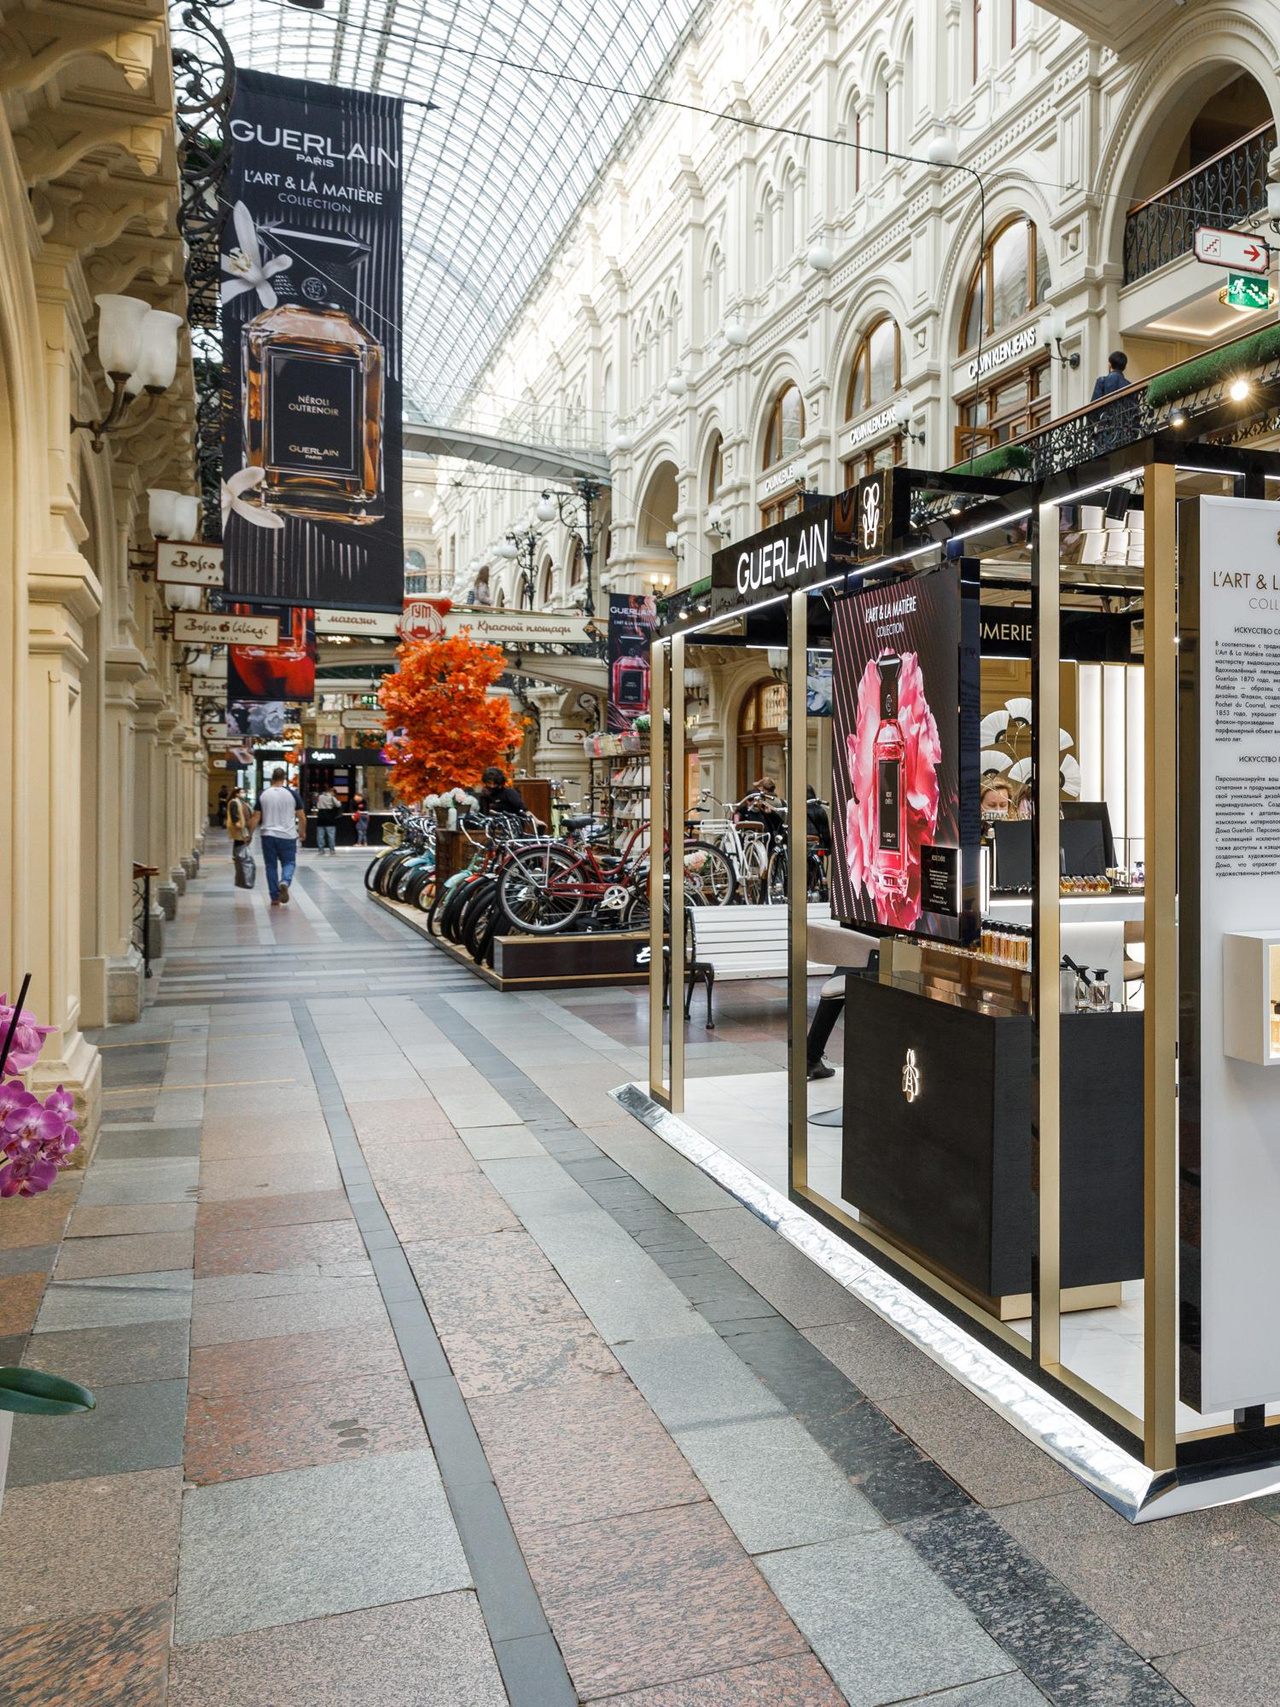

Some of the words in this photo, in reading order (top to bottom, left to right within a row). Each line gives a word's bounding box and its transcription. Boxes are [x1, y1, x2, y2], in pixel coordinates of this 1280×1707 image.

[229, 119, 399, 169] GUERLAIN
[296, 153, 335, 168] PARIS
[244, 169, 281, 187] L'ART
[284, 176, 296, 190] &
[300, 178, 319, 194] LA
[322, 183, 384, 206] MATIÈRE
[278, 192, 352, 214] COLLECTION
[968, 352, 992, 379] CALVIN
[992, 340, 1011, 366] KLEIN
[1011, 327, 1036, 357] JEANS
[297, 395, 330, 406] NÉROLI
[288, 403, 339, 416] OUTRENOIR
[288, 444, 339, 457] GUERLAIN
[171, 551, 216, 573] Bosco
[737, 519, 828, 595] GUERLAIN
[1213, 571, 1251, 588] L'ART
[1256, 574, 1267, 589] &
[411, 604, 432, 619] ГУМ
[885, 603, 892, 619] LA
[893, 594, 917, 617] MATIÈRE
[184, 618, 217, 634] Bosco
[327, 615, 377, 626] магазин
[459, 622, 473, 631] на
[477, 619, 524, 634] Красной
[526, 623, 571, 635] площади
[876, 621, 905, 638] COLLECTION
[1234, 626, 1272, 635] ИСКУССТВО
[311, 752, 336, 762] dyson
